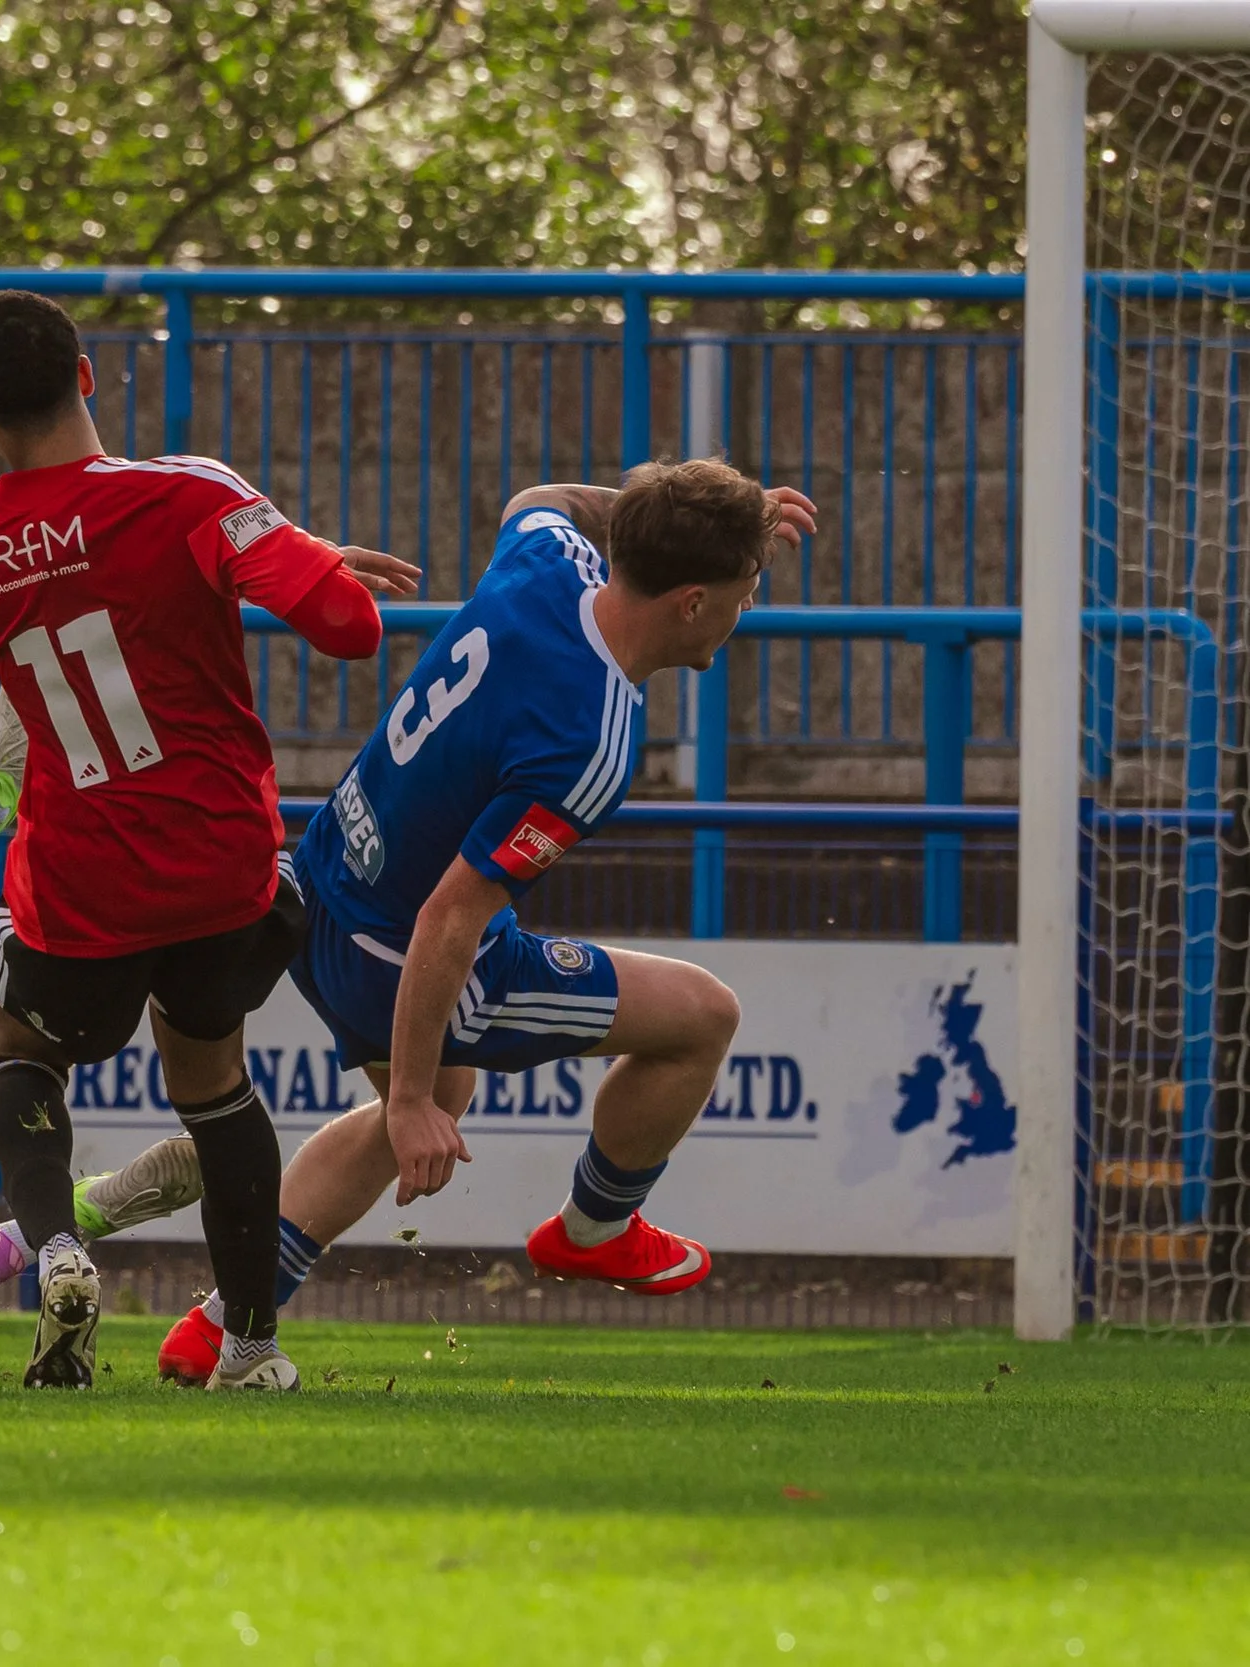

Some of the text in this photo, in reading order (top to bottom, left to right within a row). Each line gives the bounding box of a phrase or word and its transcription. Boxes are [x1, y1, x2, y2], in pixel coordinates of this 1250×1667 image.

[230, 503, 276, 532] PITCHING
[255, 517, 272, 530] IN
[59, 561, 90, 576] more
[8, 608, 164, 790] 11
[386, 626, 490, 767] 3
